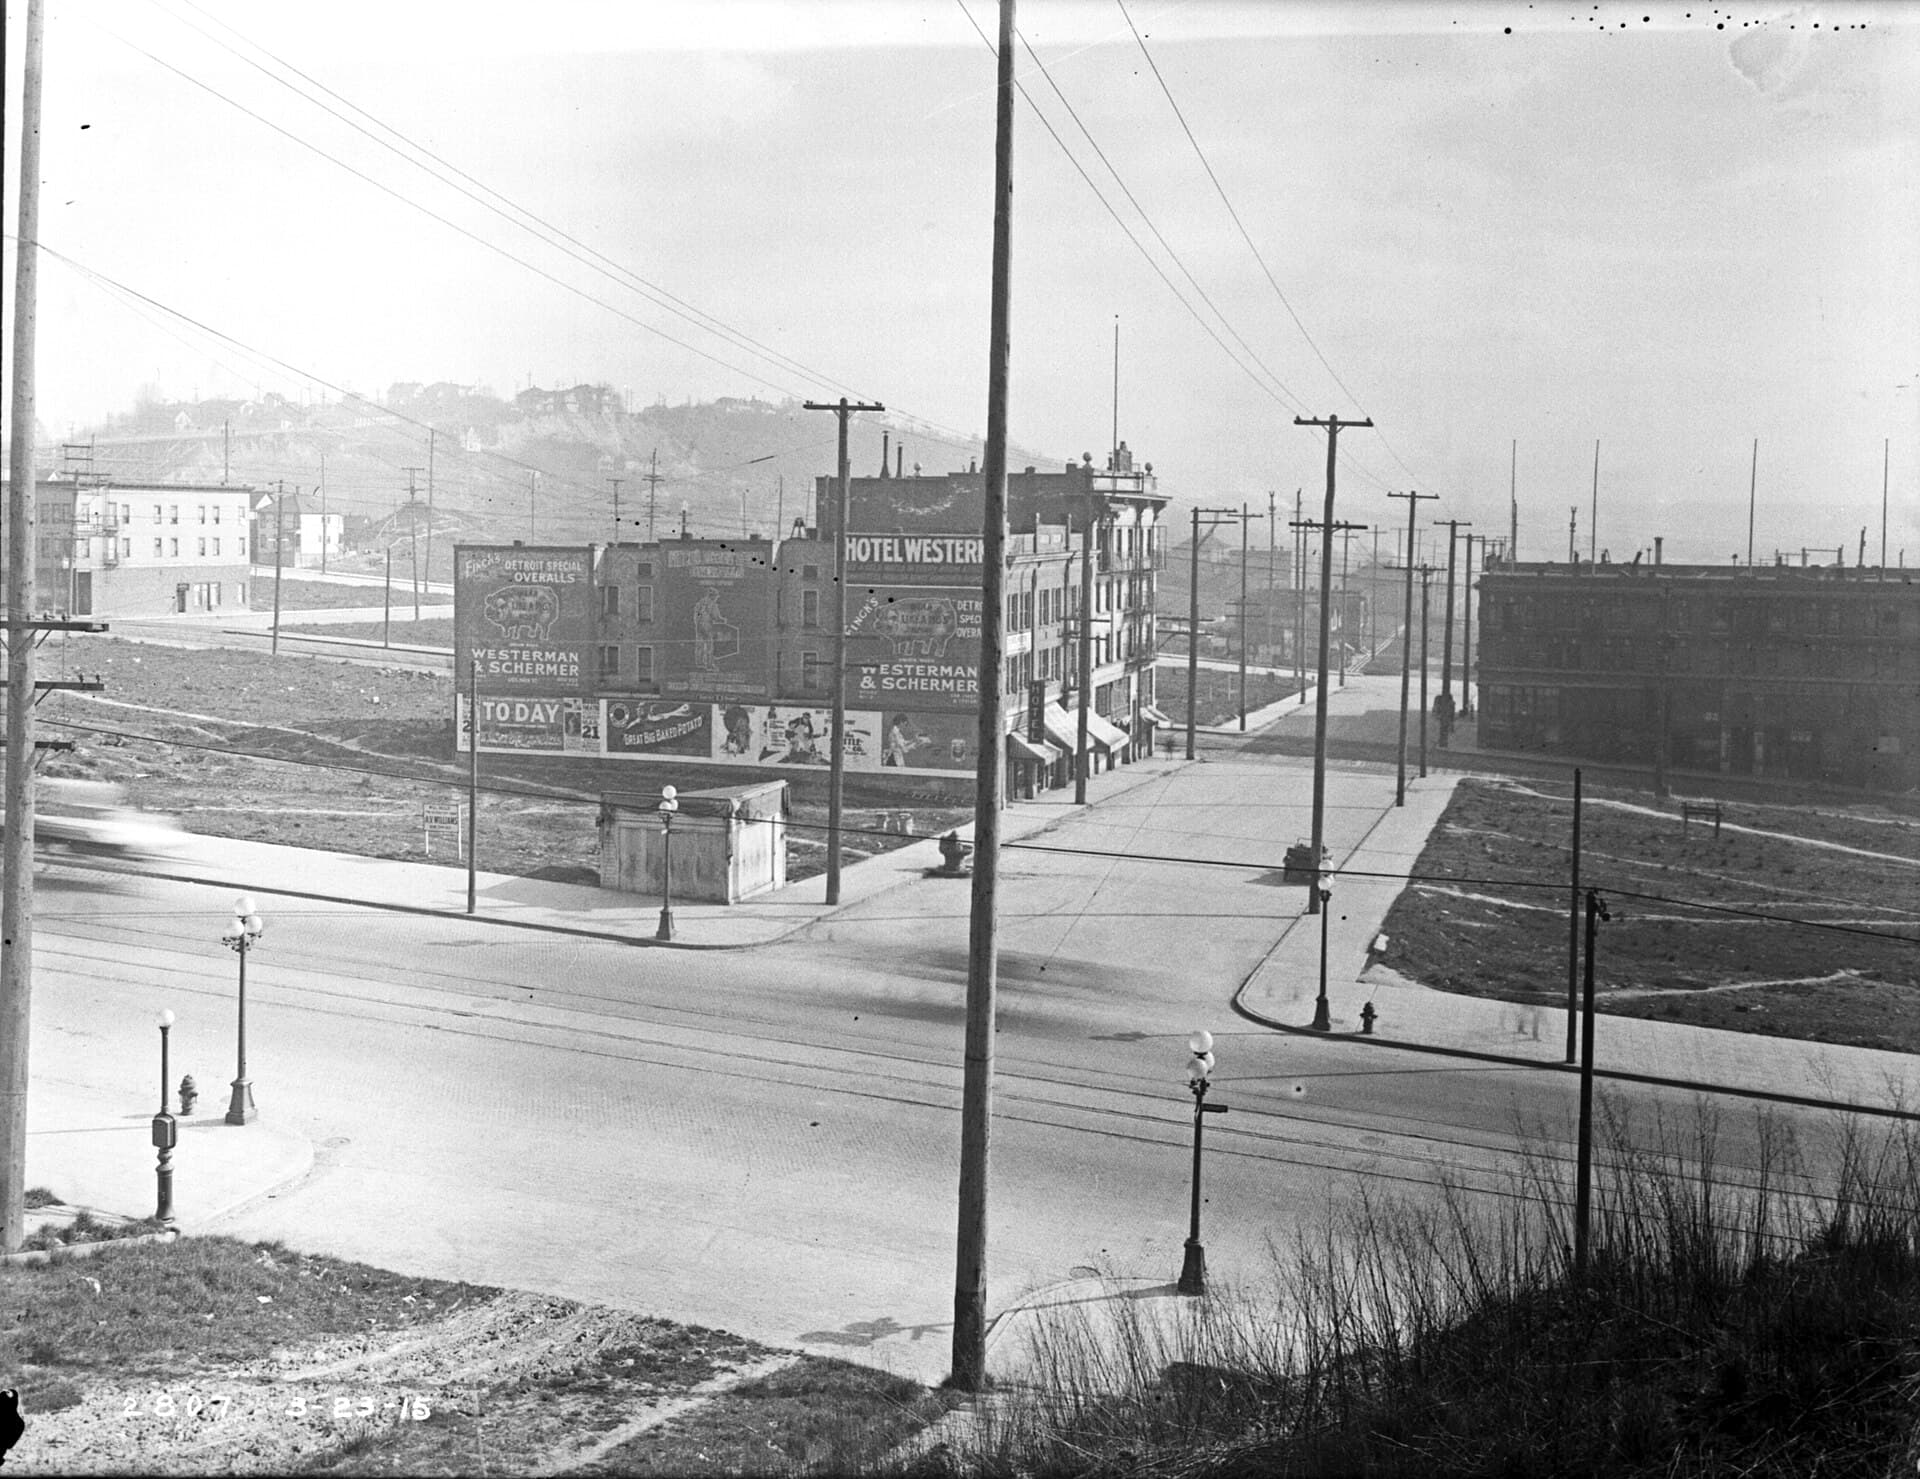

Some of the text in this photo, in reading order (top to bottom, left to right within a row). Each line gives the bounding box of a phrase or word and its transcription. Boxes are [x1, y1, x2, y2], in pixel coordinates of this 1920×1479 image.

[845, 537, 903, 562] HOTEL
[505, 560, 582, 571] DETROIT SPECIAL
[514, 572, 576, 583] OVERALLS
[472, 648, 579, 662] WESTERMAN
[474, 660, 579, 676] & SCHERMER
[861, 664, 978, 678] WESTERMAN
[860, 676, 979, 692] & SCHERMER
[1031, 684, 1040, 741] HOTEL
[582, 725, 600, 739] 21
